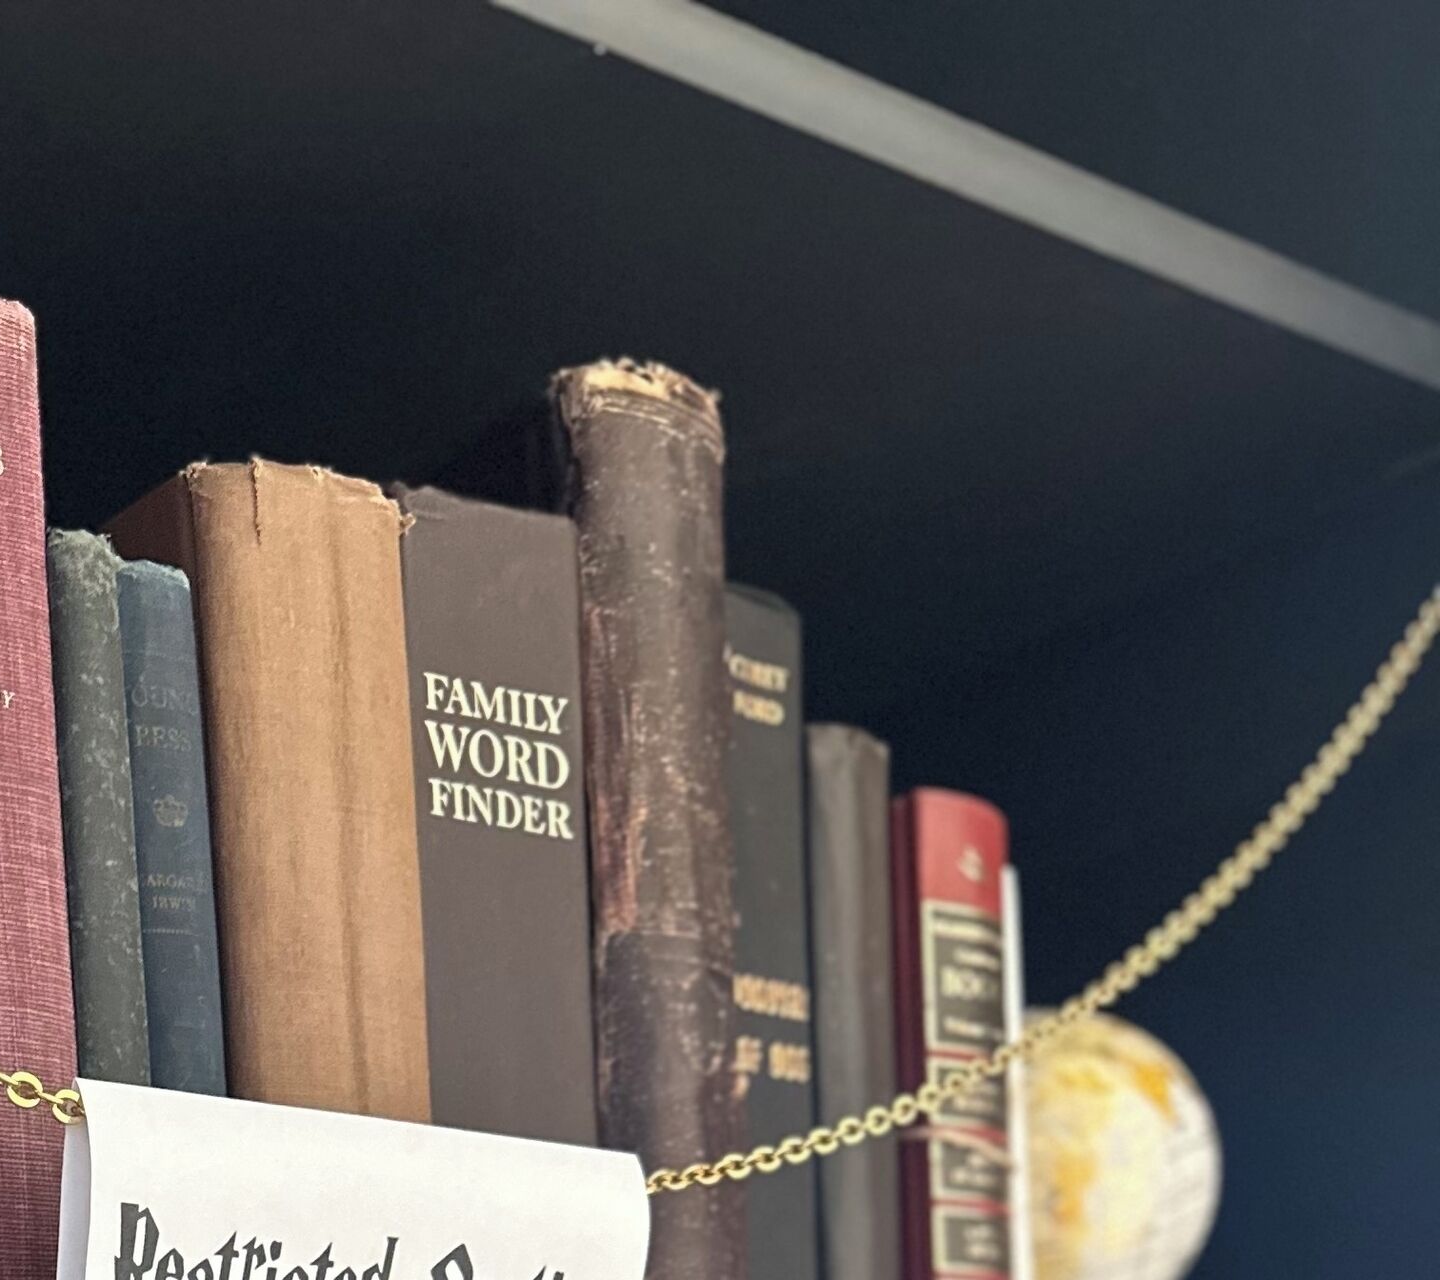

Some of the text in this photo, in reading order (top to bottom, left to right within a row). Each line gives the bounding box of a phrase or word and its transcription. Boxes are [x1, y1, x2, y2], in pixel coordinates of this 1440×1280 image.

[423, 672, 568, 734] FAMILY
[424, 720, 570, 789] WORD
[428, 778, 574, 840] FINDER
